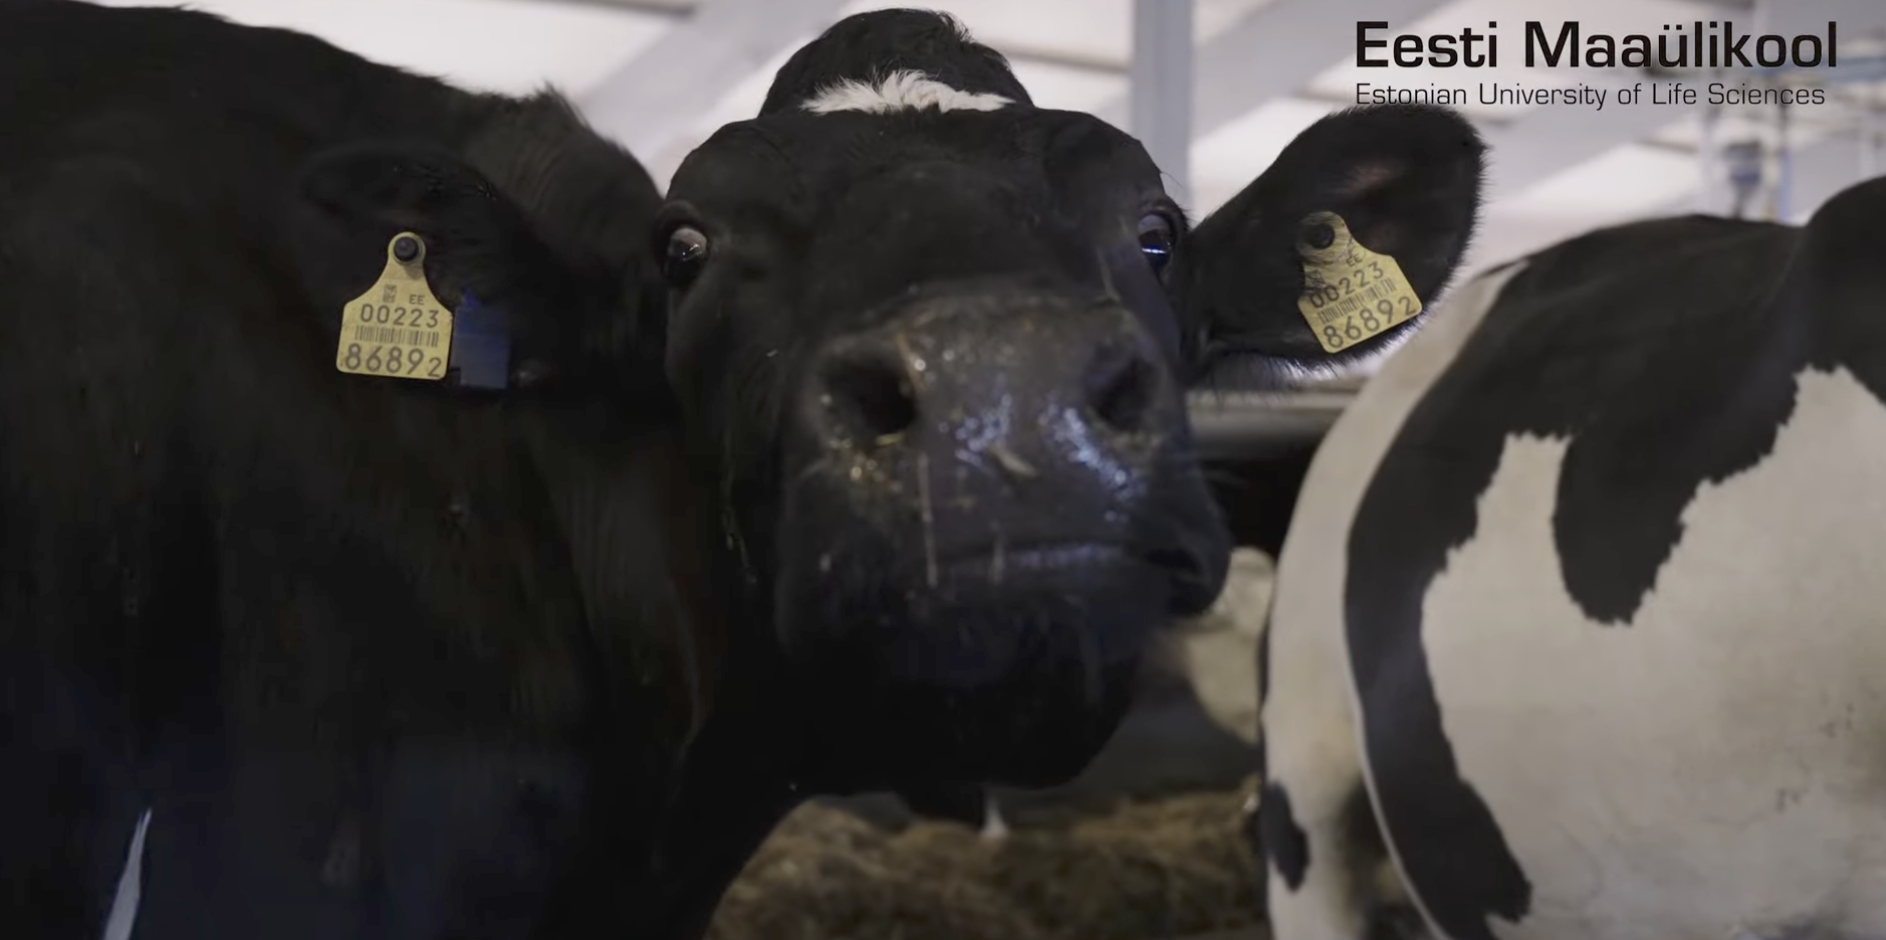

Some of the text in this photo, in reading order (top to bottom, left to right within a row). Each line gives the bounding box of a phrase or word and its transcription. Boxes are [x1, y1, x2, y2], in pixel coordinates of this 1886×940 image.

[1346, 253, 1362, 267] EE
[1309, 261, 1384, 308] 00223
[409, 294, 425, 305] EE
[360, 303, 439, 328] 00223
[1323, 296, 1417, 348] 86892
[345, 343, 442, 377] 86892
